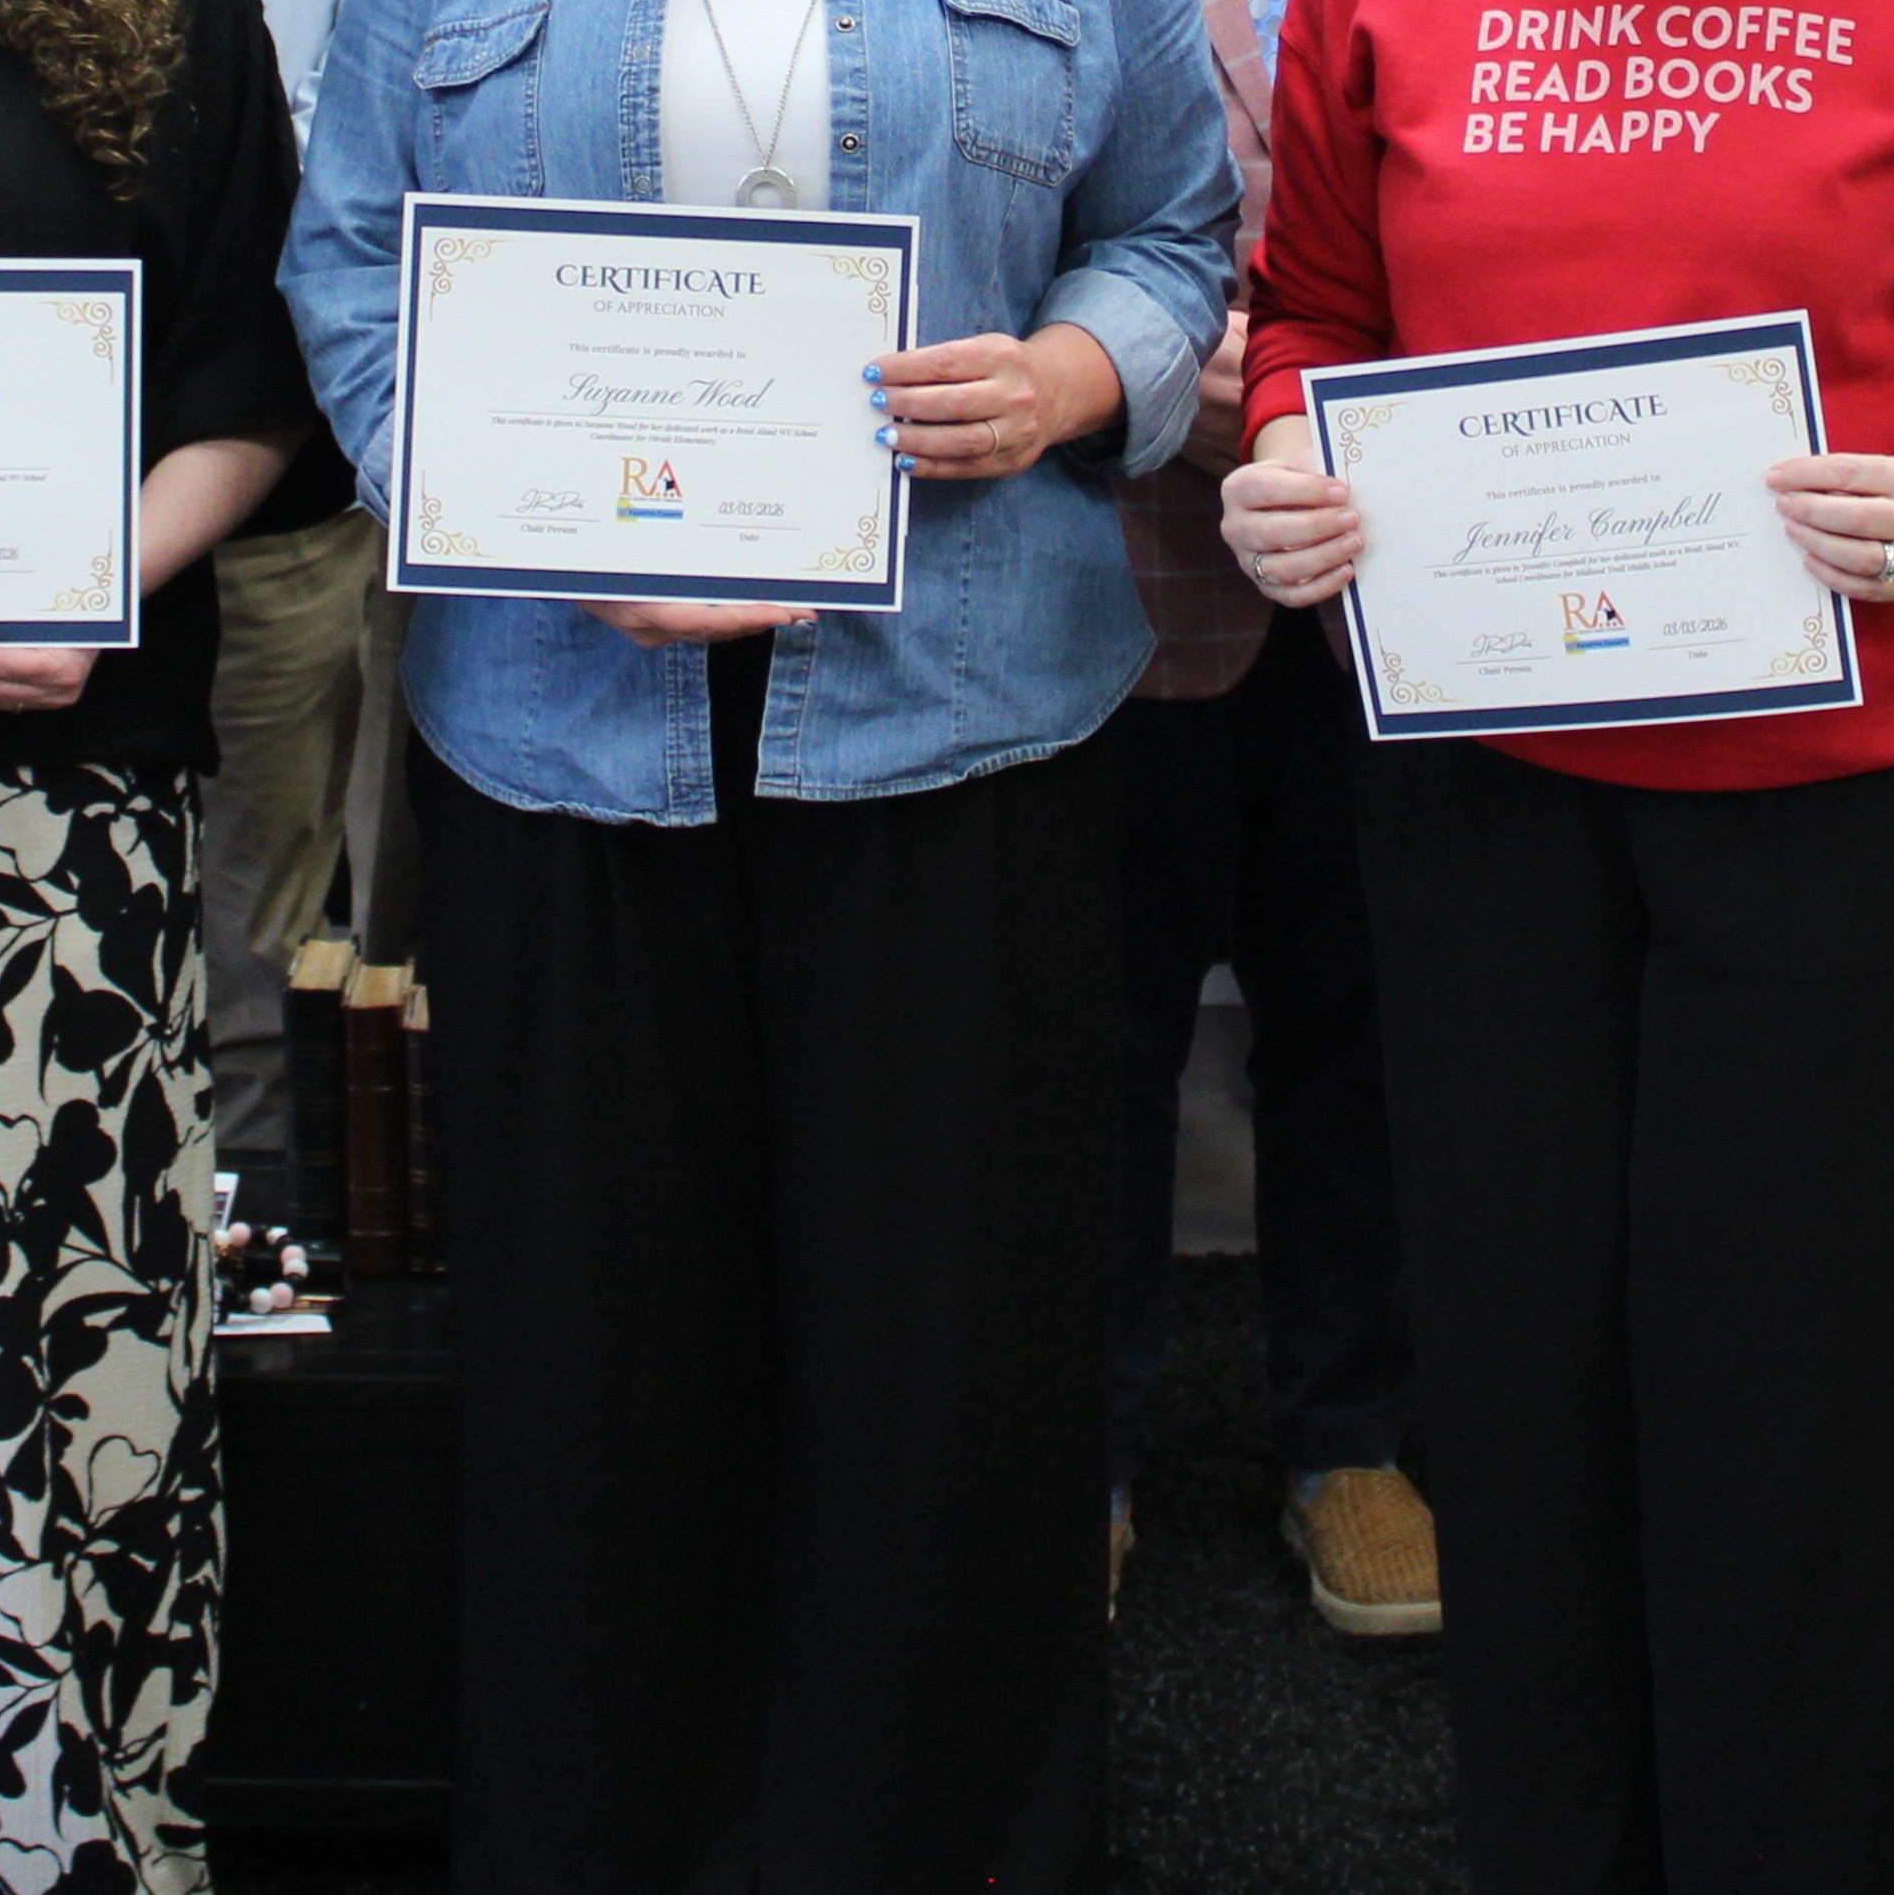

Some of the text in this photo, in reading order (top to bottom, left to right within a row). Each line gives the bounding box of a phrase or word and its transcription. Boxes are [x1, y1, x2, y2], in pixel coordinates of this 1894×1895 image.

[1476, 3, 1857, 66] DRINK COFFEE
[1470, 55, 1814, 114] READ BOOKS
[1462, 109, 1721, 155] BE HAPPY
[555, 263, 766, 299] CERTIFICATE
[593, 300, 725, 318] OF APPRECIATION
[569, 343, 746, 360] This certificate is proudly awarded to
[562, 373, 774, 416] Suzanne Wood
[1459, 394, 1668, 438] CERTIFICATE
[1501, 433, 1632, 458] OF APPRECIATION
[1486, 474, 1661, 501] This certificate is proudly awarded to
[520, 523, 577, 535] Chair Person
[739, 533, 759, 542] Date
[1452, 492, 1722, 564] Jennifer Campbell
[1688, 650, 1708, 659] Date
[1478, 665, 1532, 675] Chair Person
